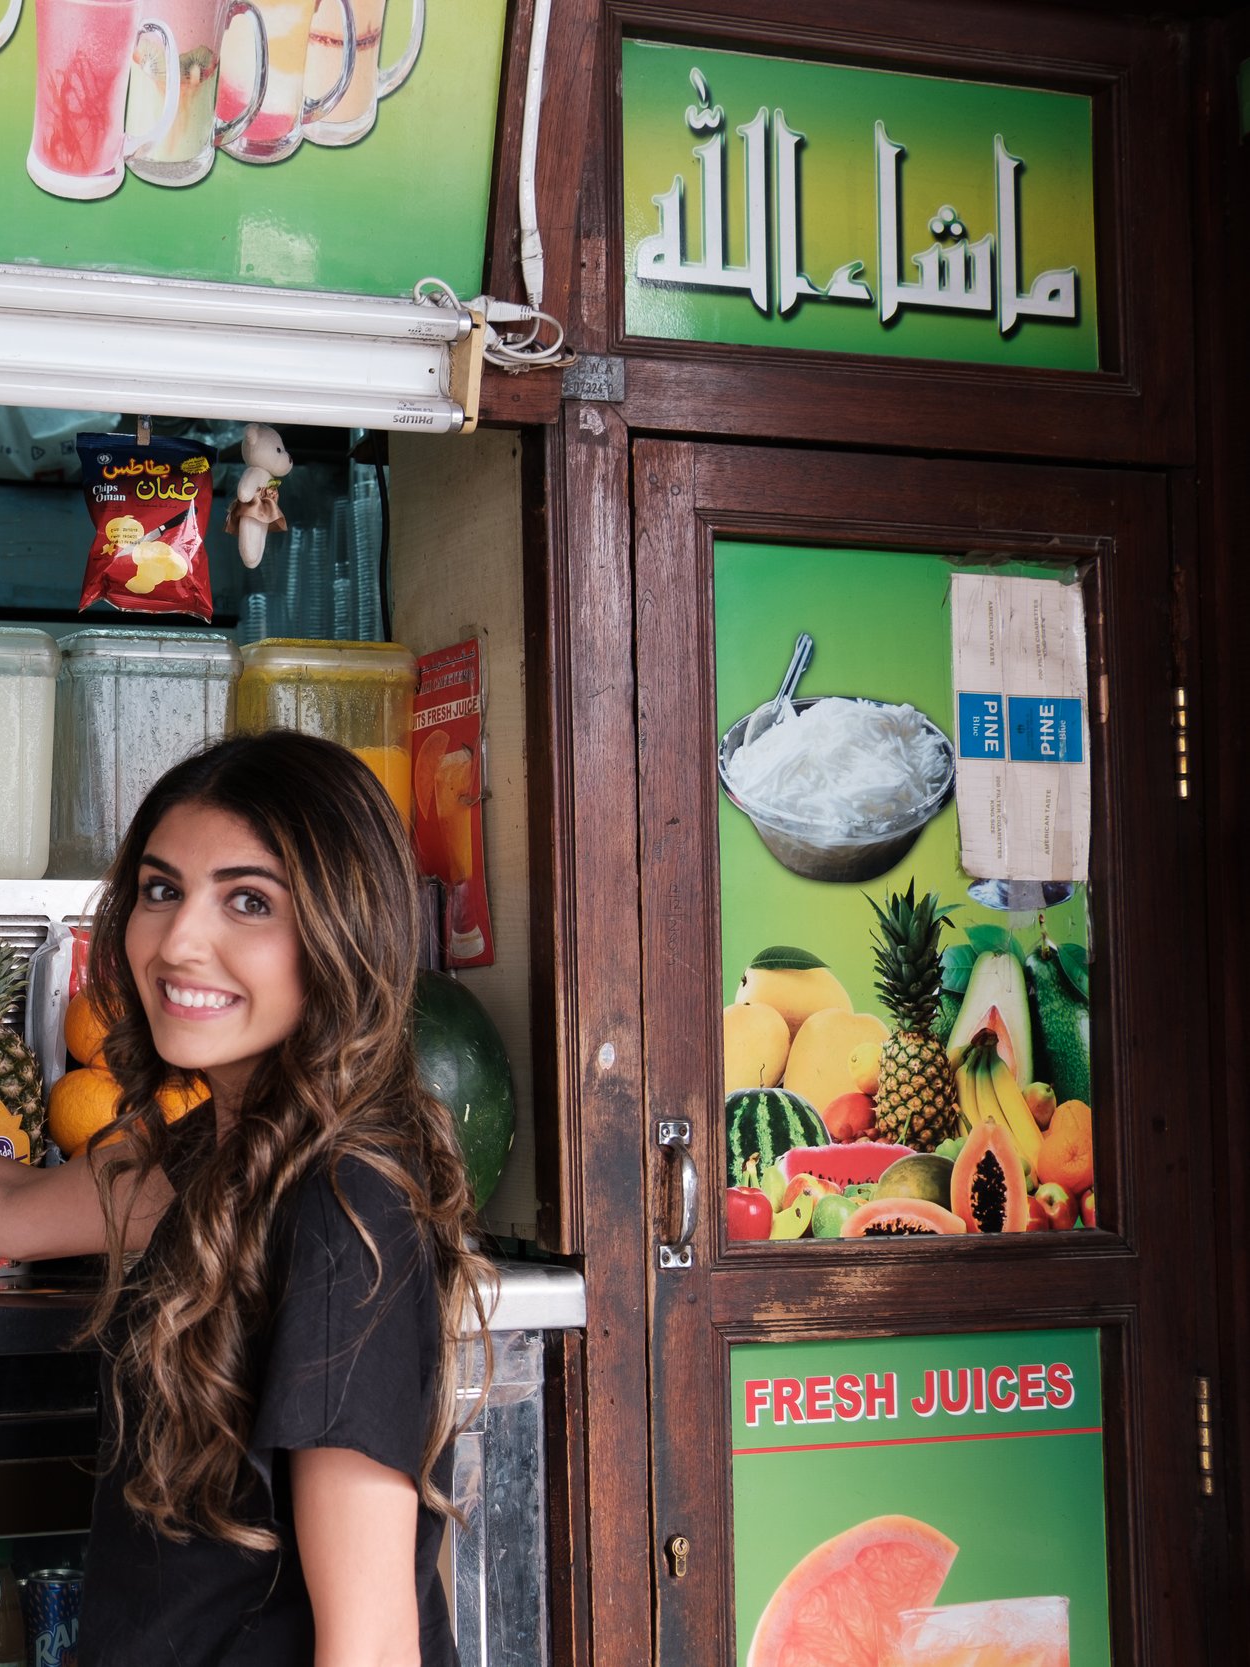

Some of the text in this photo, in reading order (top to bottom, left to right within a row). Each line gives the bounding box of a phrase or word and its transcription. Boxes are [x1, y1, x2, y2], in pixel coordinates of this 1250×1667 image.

[393, 414, 434, 425] PHILIPS
[92, 483, 119, 496] Chips
[95, 491, 126, 503] Oman
[427, 705, 452, 726] FRESH
[453, 698, 478, 718] JUICE
[984, 701, 999, 752] PINE
[1040, 704, 1055, 755] PINE
[745, 1361, 1075, 1427] FRESH JUICES
